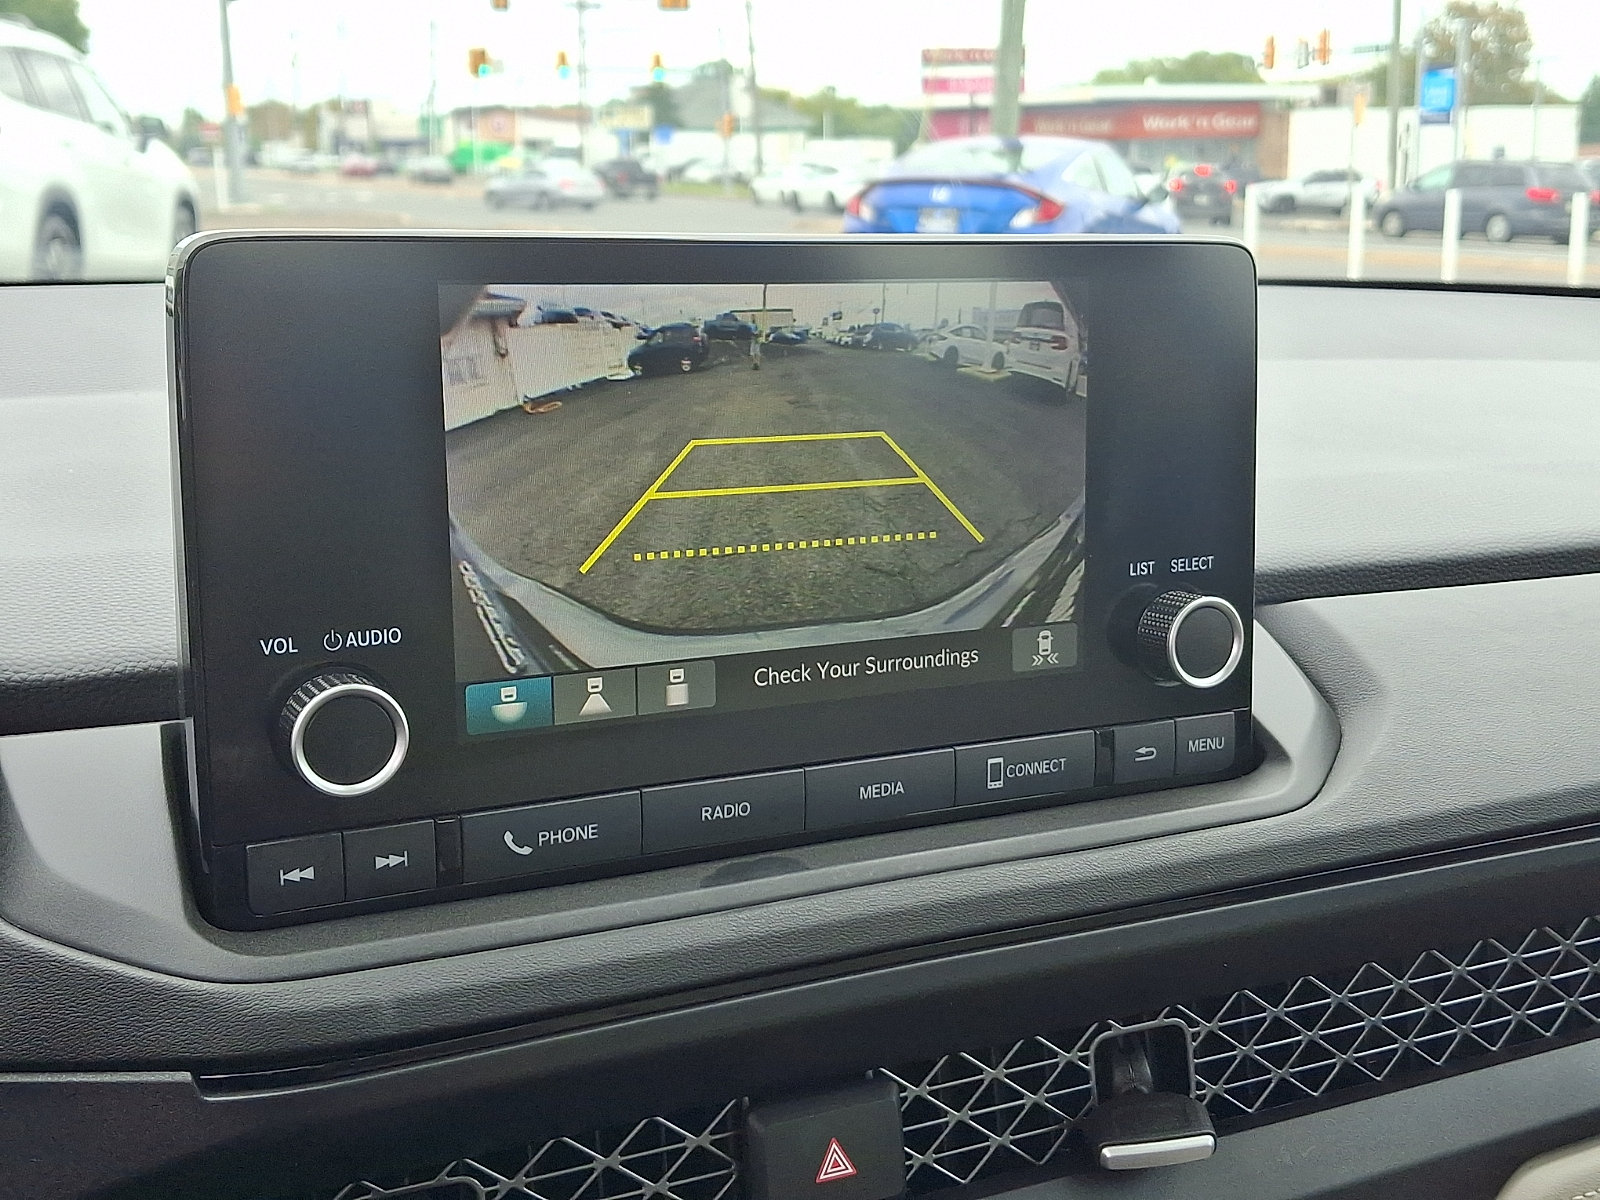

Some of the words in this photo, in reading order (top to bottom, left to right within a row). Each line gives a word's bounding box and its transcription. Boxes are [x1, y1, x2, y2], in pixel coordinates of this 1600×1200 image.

[1129, 561, 1156, 577] LIST
[1170, 555, 1214, 573] SELECT
[259, 637, 298, 656] VOL
[345, 627, 402, 649] AUDIO
[753, 664, 812, 687] Check
[816, 662, 861, 681] Your
[864, 646, 980, 674] Surroundings
[1188, 736, 1225, 754] MENU
[1006, 757, 1067, 778] CONNECT
[859, 781, 905, 800] MEDIA
[700, 801, 751, 821] RADIO
[538, 823, 599, 846] PHONE
